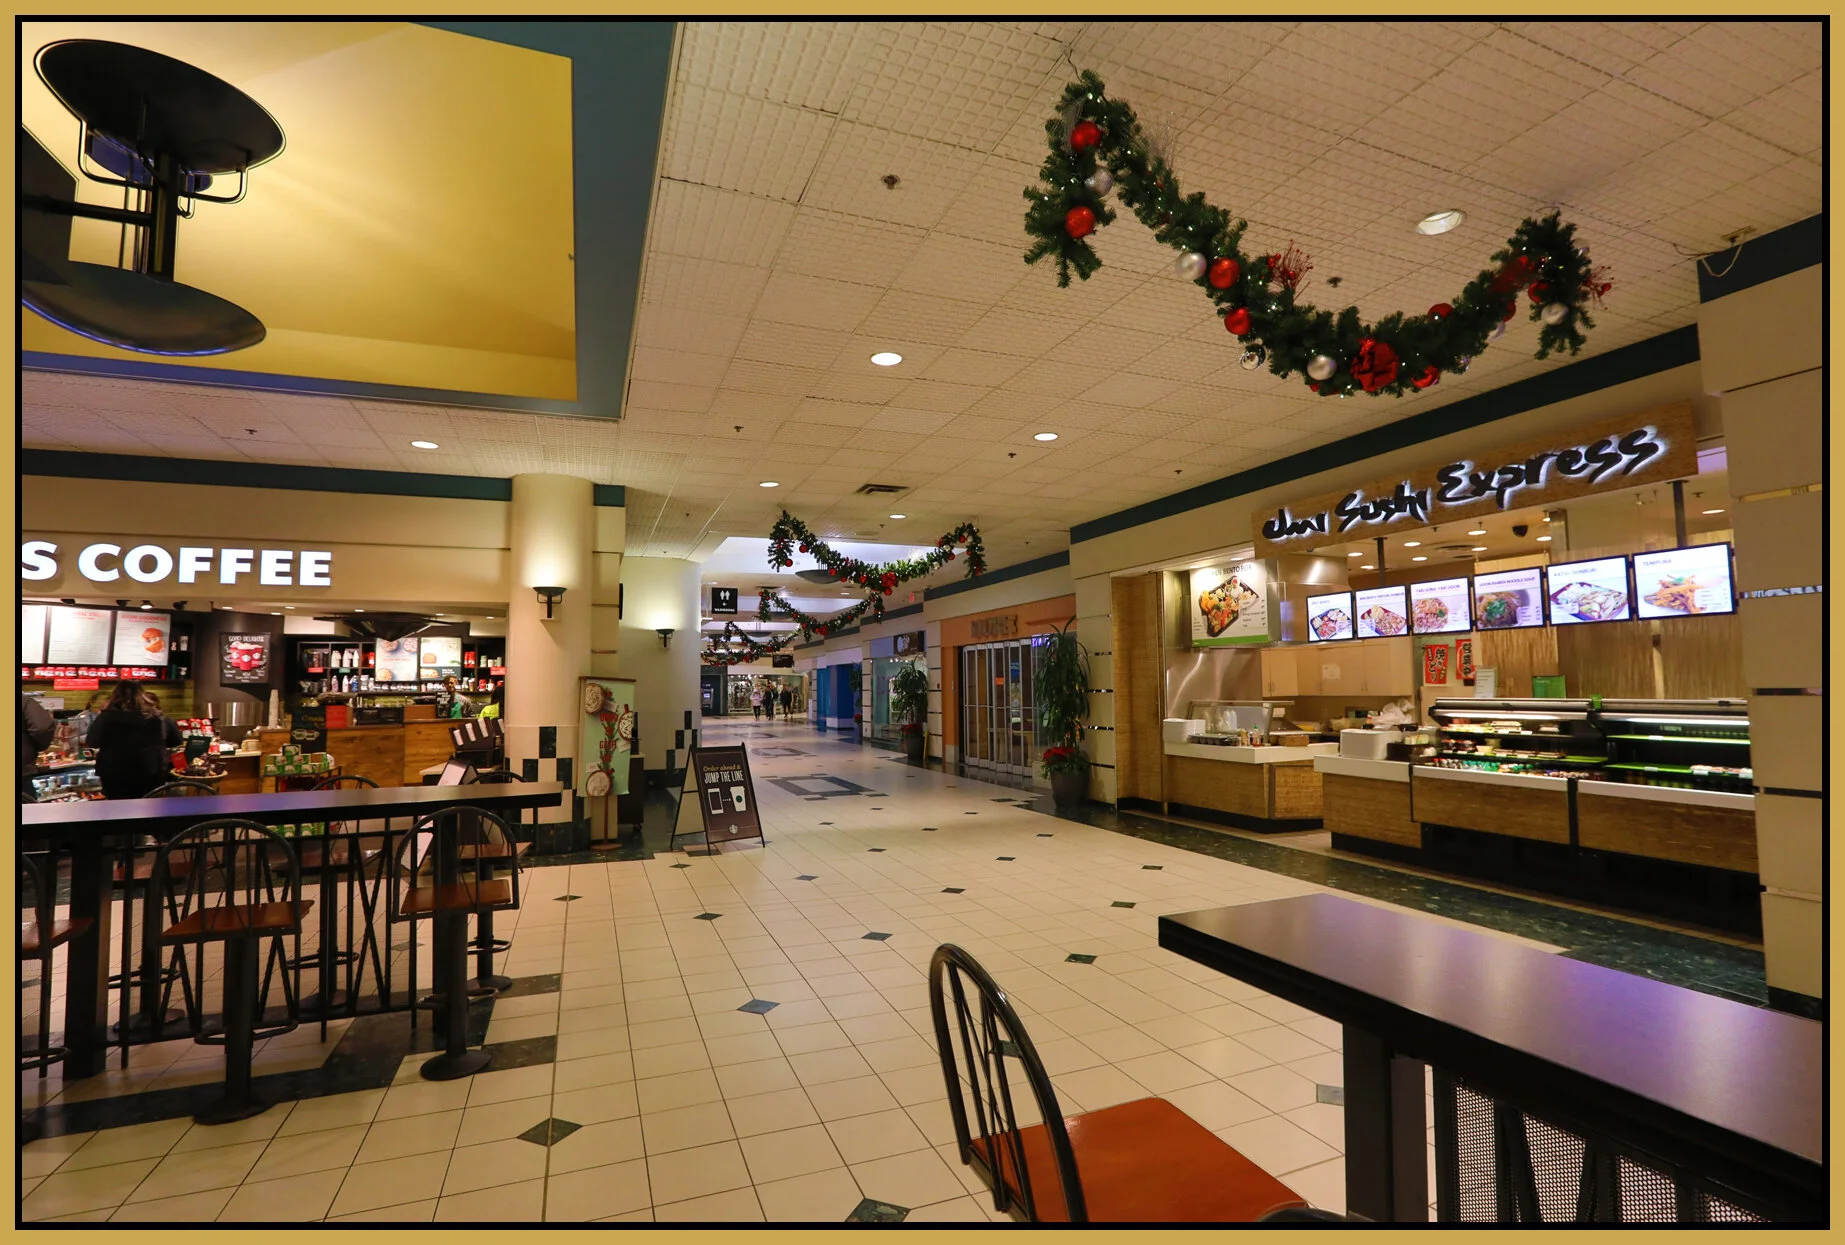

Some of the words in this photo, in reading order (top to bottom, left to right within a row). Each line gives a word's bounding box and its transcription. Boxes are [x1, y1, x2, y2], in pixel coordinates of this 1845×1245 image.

[1335, 481, 1431, 533] Sushi
[1437, 427, 1663, 509] Express
[78, 543, 332, 587] COFFEE
[704, 771, 720, 784] JUMP
[720, 771, 731, 782] THE
[731, 770, 744, 782] LINE
